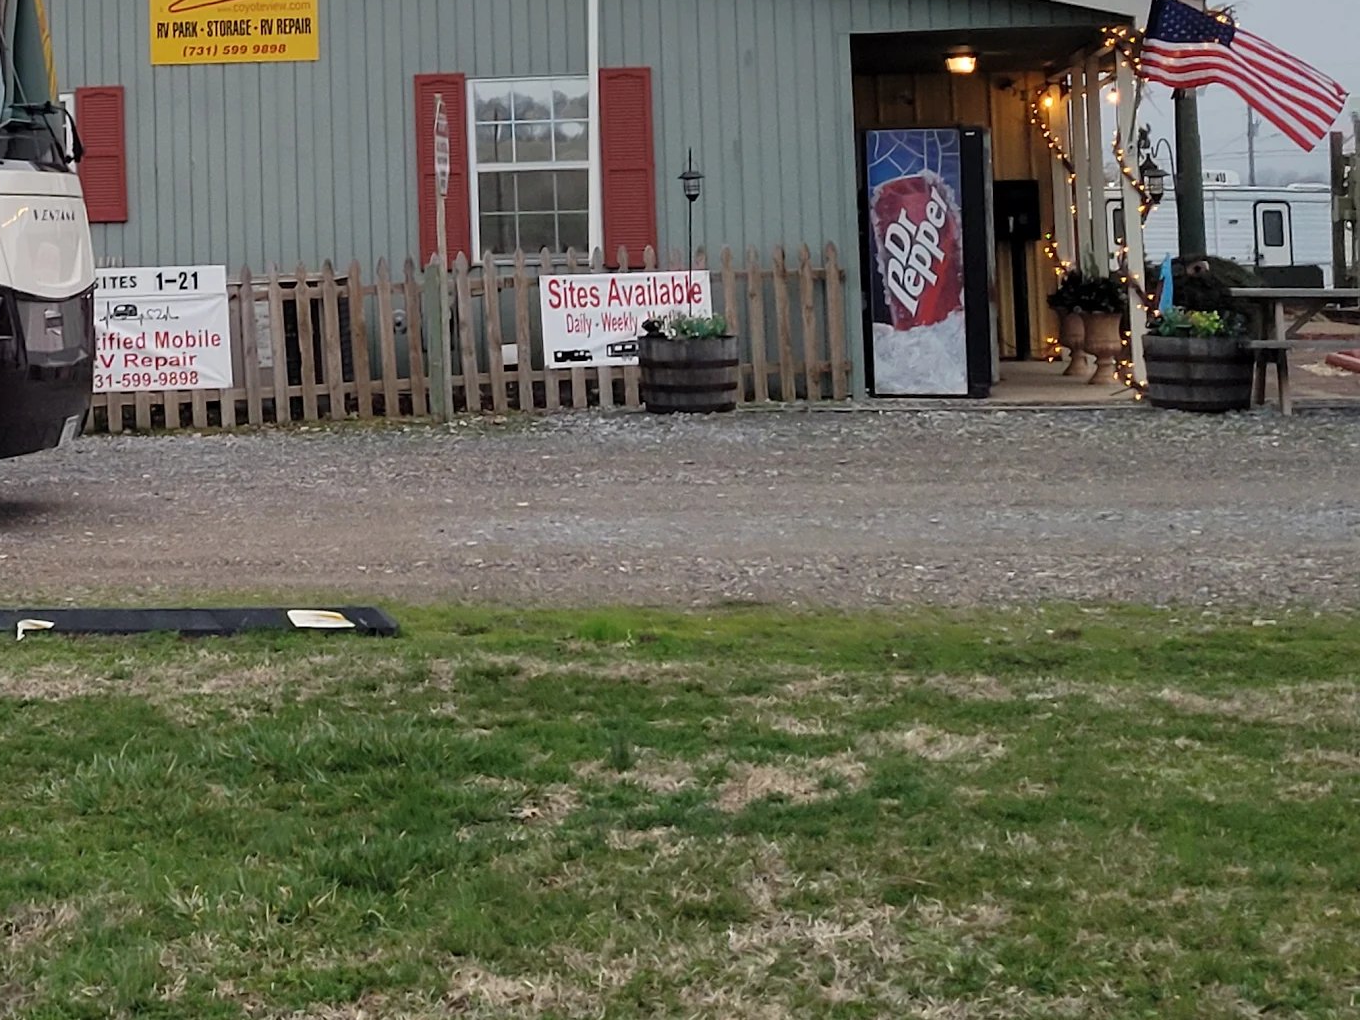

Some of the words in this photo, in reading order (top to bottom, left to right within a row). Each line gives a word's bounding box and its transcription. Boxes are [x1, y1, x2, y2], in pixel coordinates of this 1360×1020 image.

[157, 22, 169, 39] RV
[172, 21, 198, 38] PARK
[207, 19, 252, 37] STORAGE
[260, 18, 274, 35] RV
[276, 17, 311, 35] REPAIR
[183, 45, 218, 57] (731)
[222, 44, 247, 55] 599
[252, 44, 287, 54] 9898
[885, 207, 917, 266] Dr
[887, 186, 948, 317] Pepper
[155, 271, 198, 291] 1-21
[548, 278, 600, 309] Sites
[607, 274, 702, 308] Available
[566, 312, 592, 338] Daily
[601, 311, 638, 336] Weekly
[96, 331, 146, 350] ified
[155, 329, 221, 348] Mobile
[94, 353, 115, 369] V
[124, 352, 197, 371] Repair
[94, 370, 199, 389] 31-599-9898
